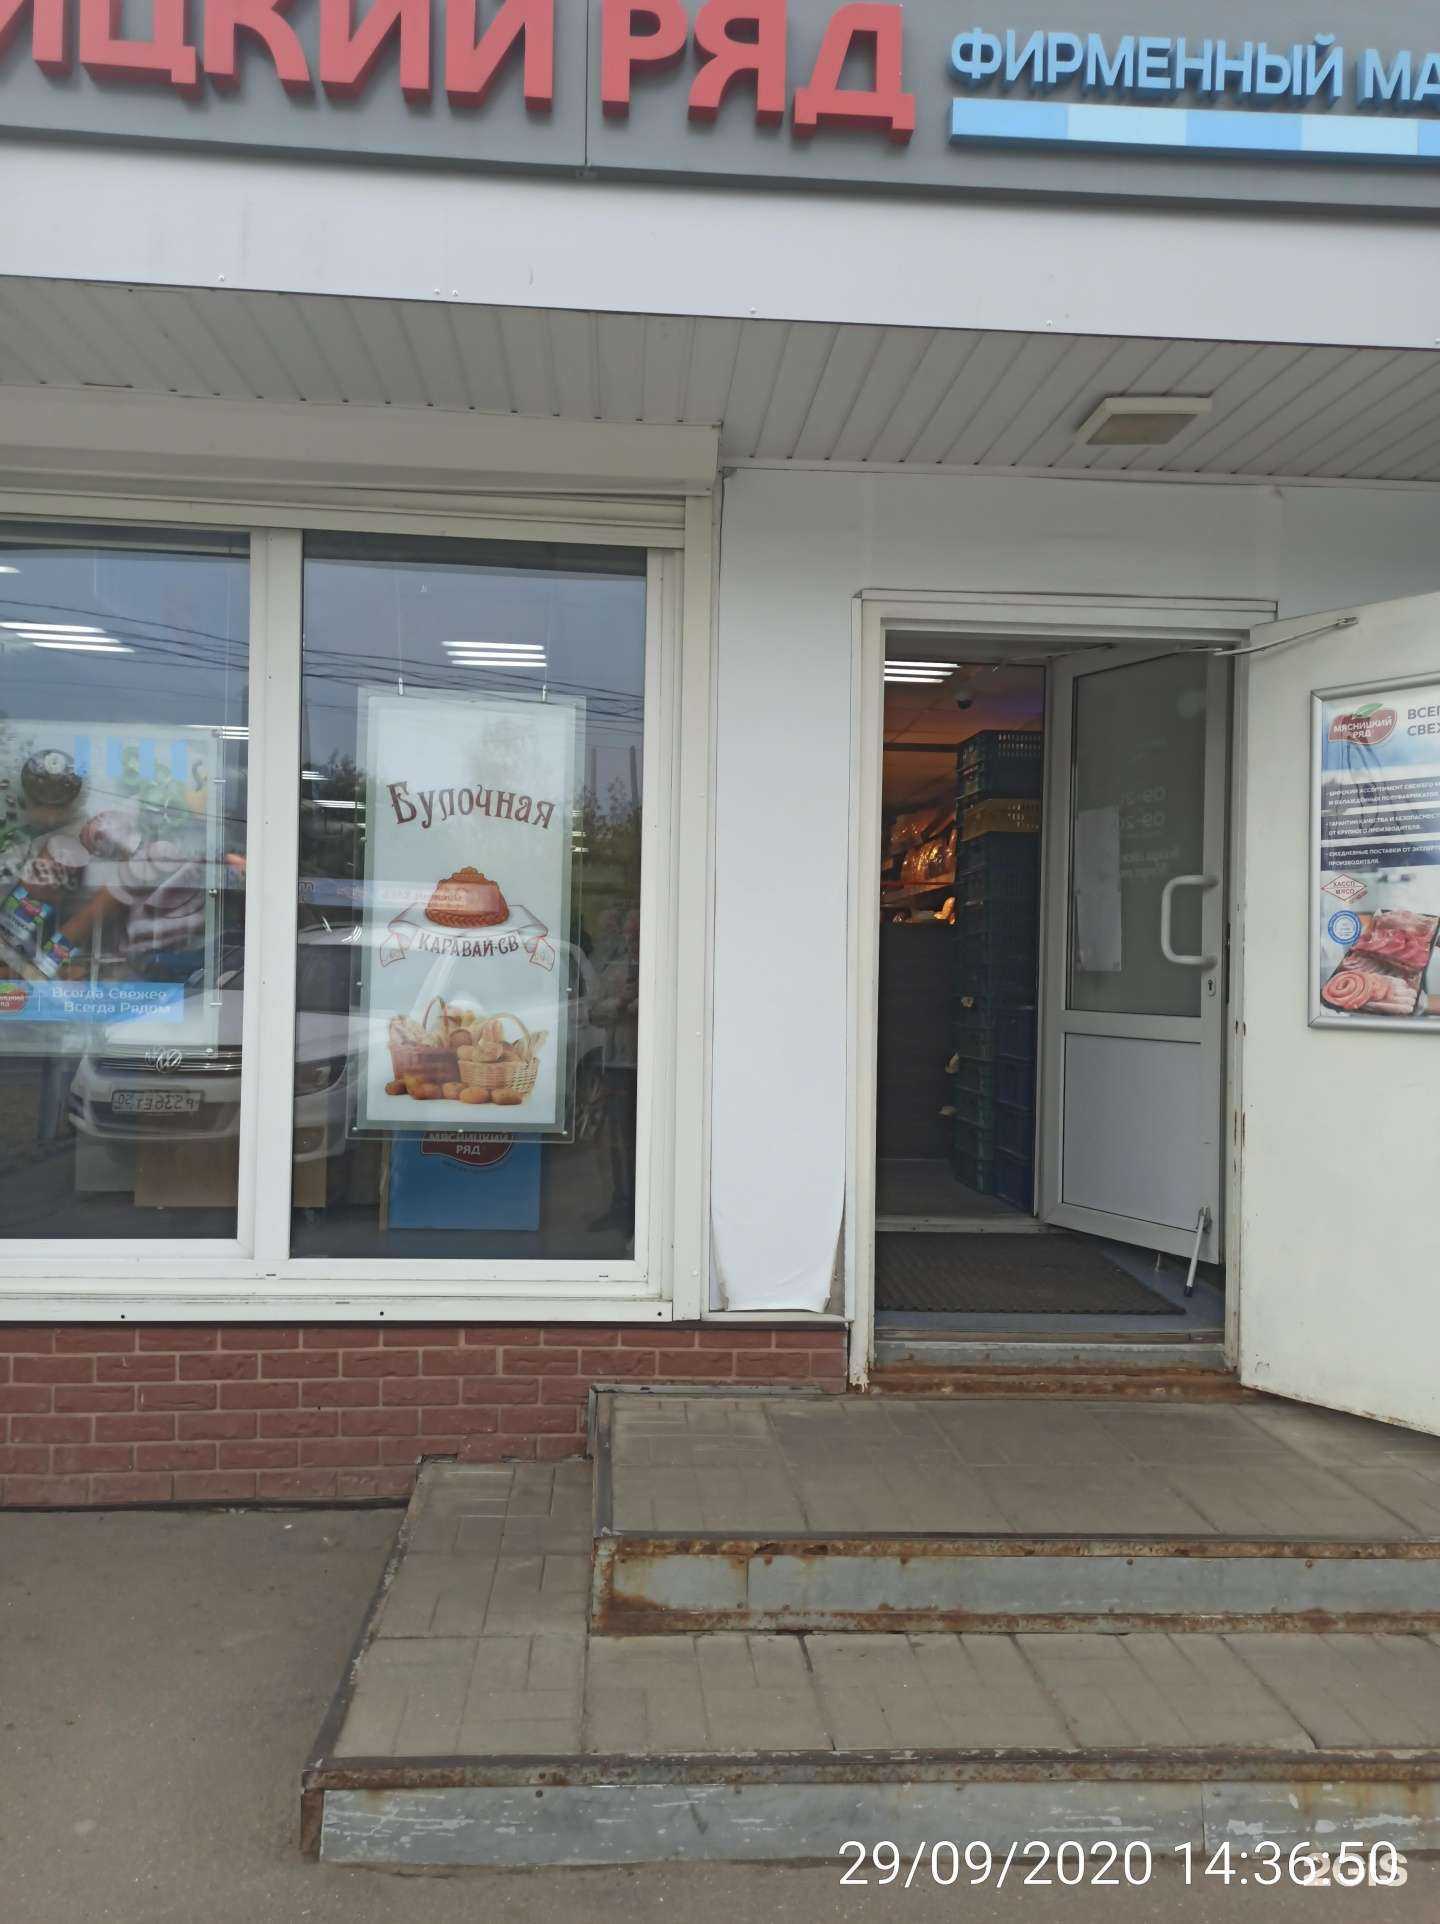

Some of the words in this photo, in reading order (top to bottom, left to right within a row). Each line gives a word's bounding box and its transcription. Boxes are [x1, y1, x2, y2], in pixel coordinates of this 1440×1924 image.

[601, 0, 915, 132] РЯД
[950, 26, 1344, 99] ФИРМЕННЫЙ
[1407, 705, 1440, 720] ВСЕ
[1333, 715, 1393, 733] МЯСНИЦКИЙ
[1352, 728, 1372, 739] РЯД
[386, 780, 557, 830] Булочная
[52, 986, 104, 1001] Всегда
[64, 1000, 116, 1015] Всегда
[120, 1001, 171, 1016] Рядом
[456, 1144, 481, 1156] РЯД
